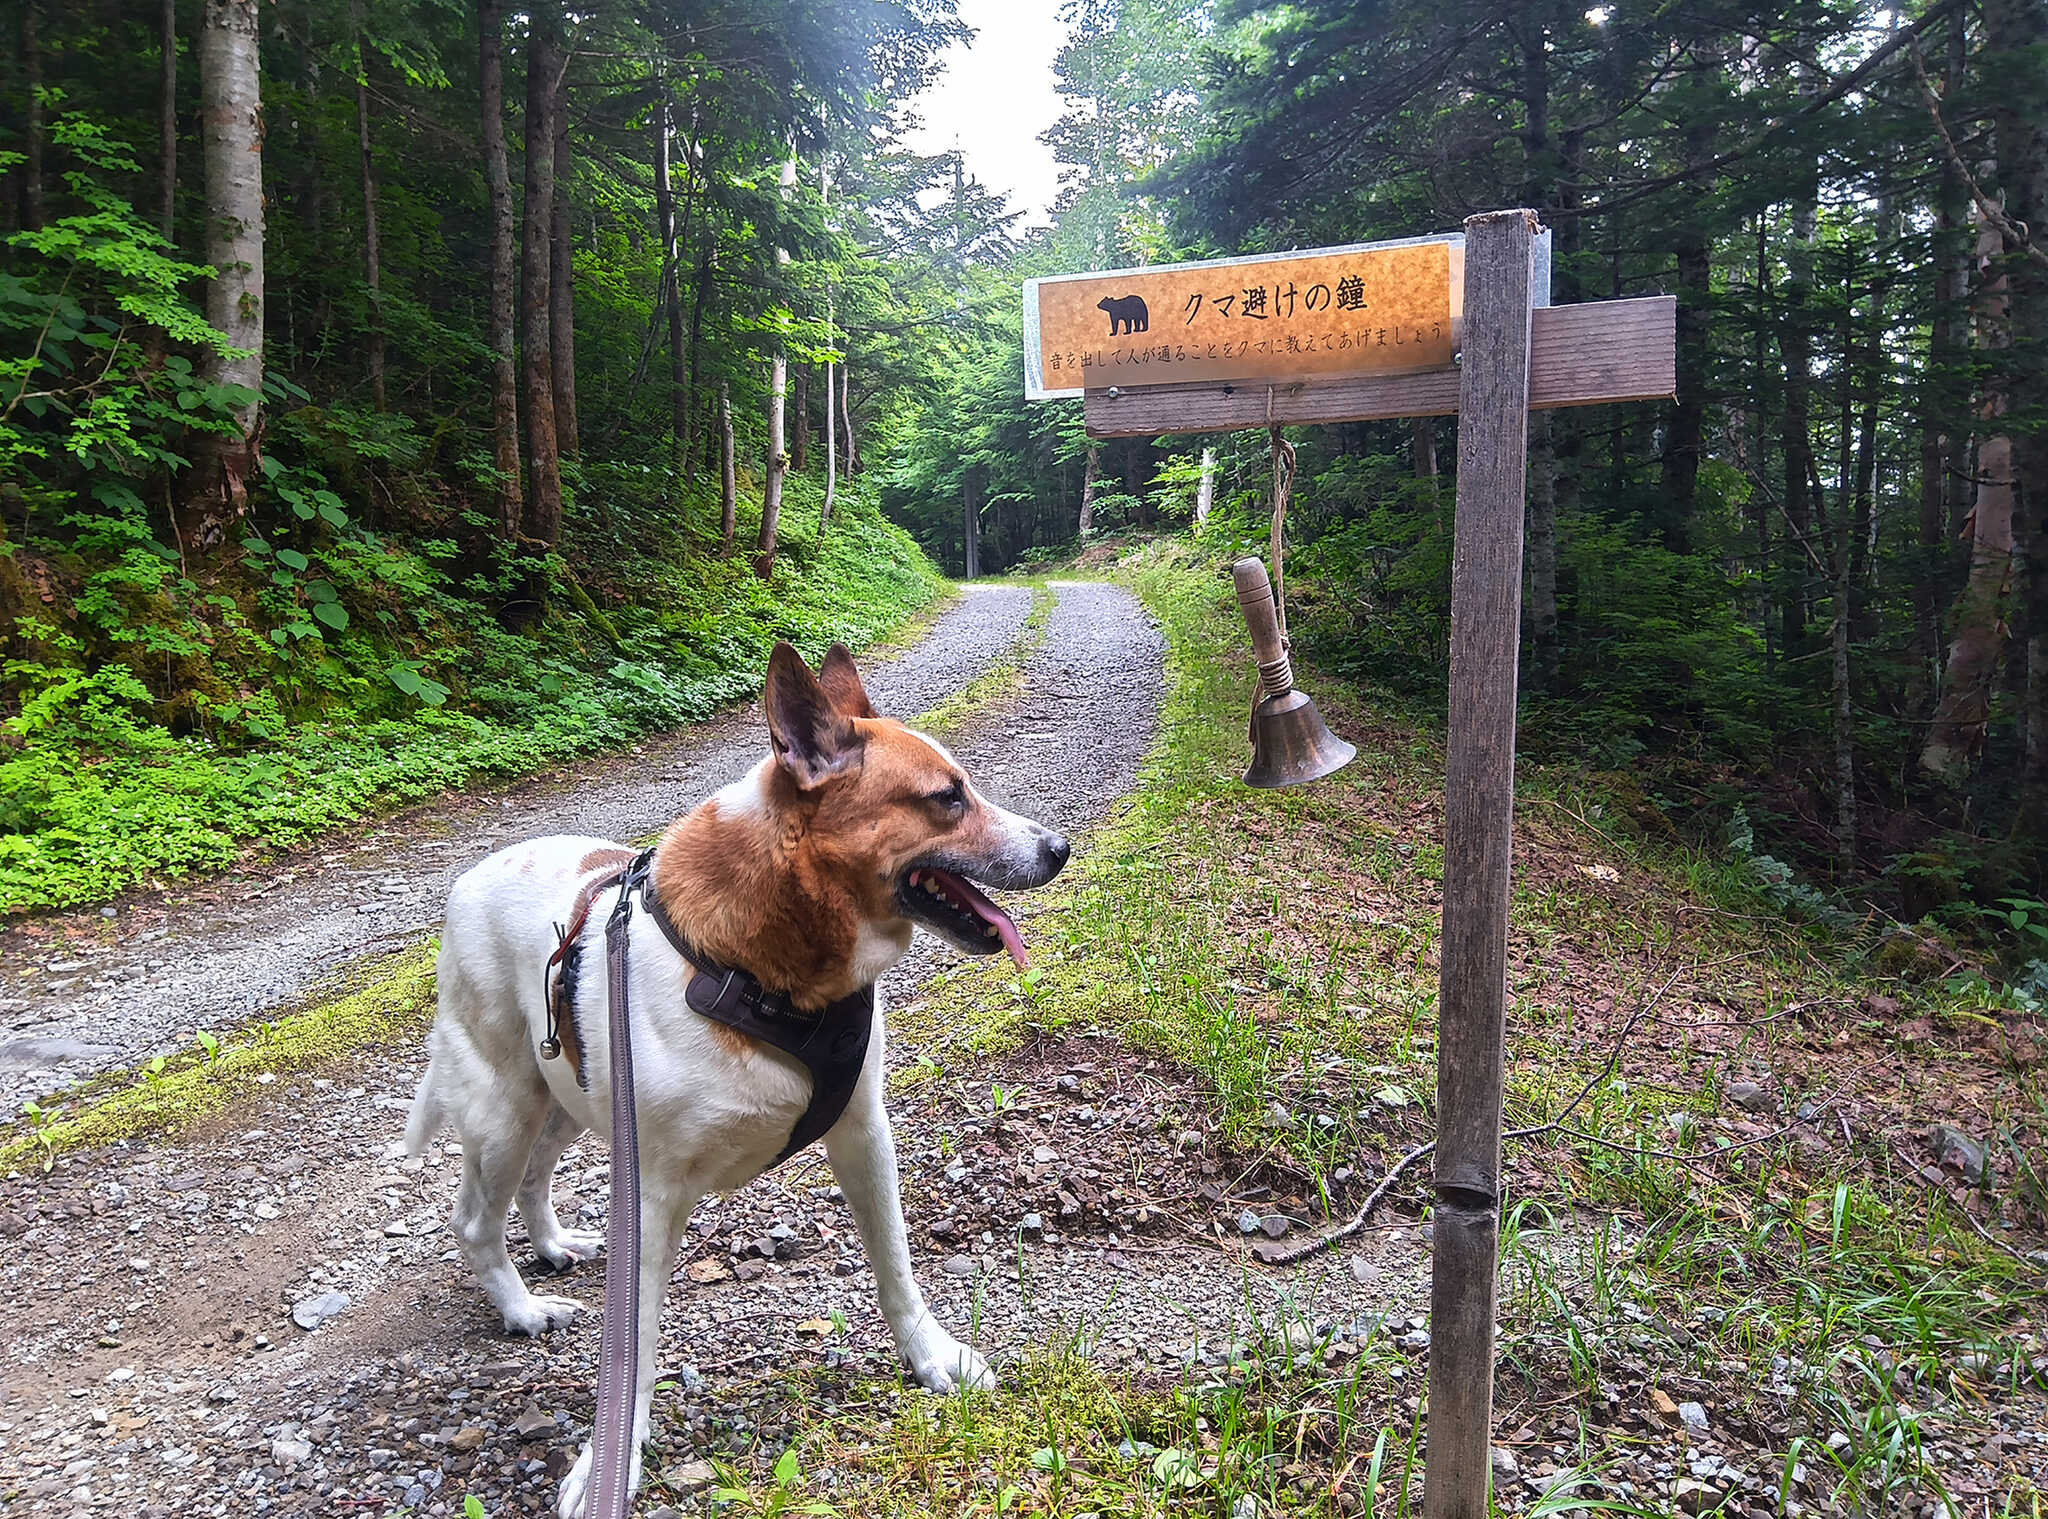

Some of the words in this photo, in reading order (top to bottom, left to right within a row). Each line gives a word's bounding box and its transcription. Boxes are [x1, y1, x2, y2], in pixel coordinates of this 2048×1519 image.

[1184, 274, 1368, 326] クマ避けの鐘
[1049, 321, 1442, 371] 音を出して人が通ることをクマに教えてあげましょう
